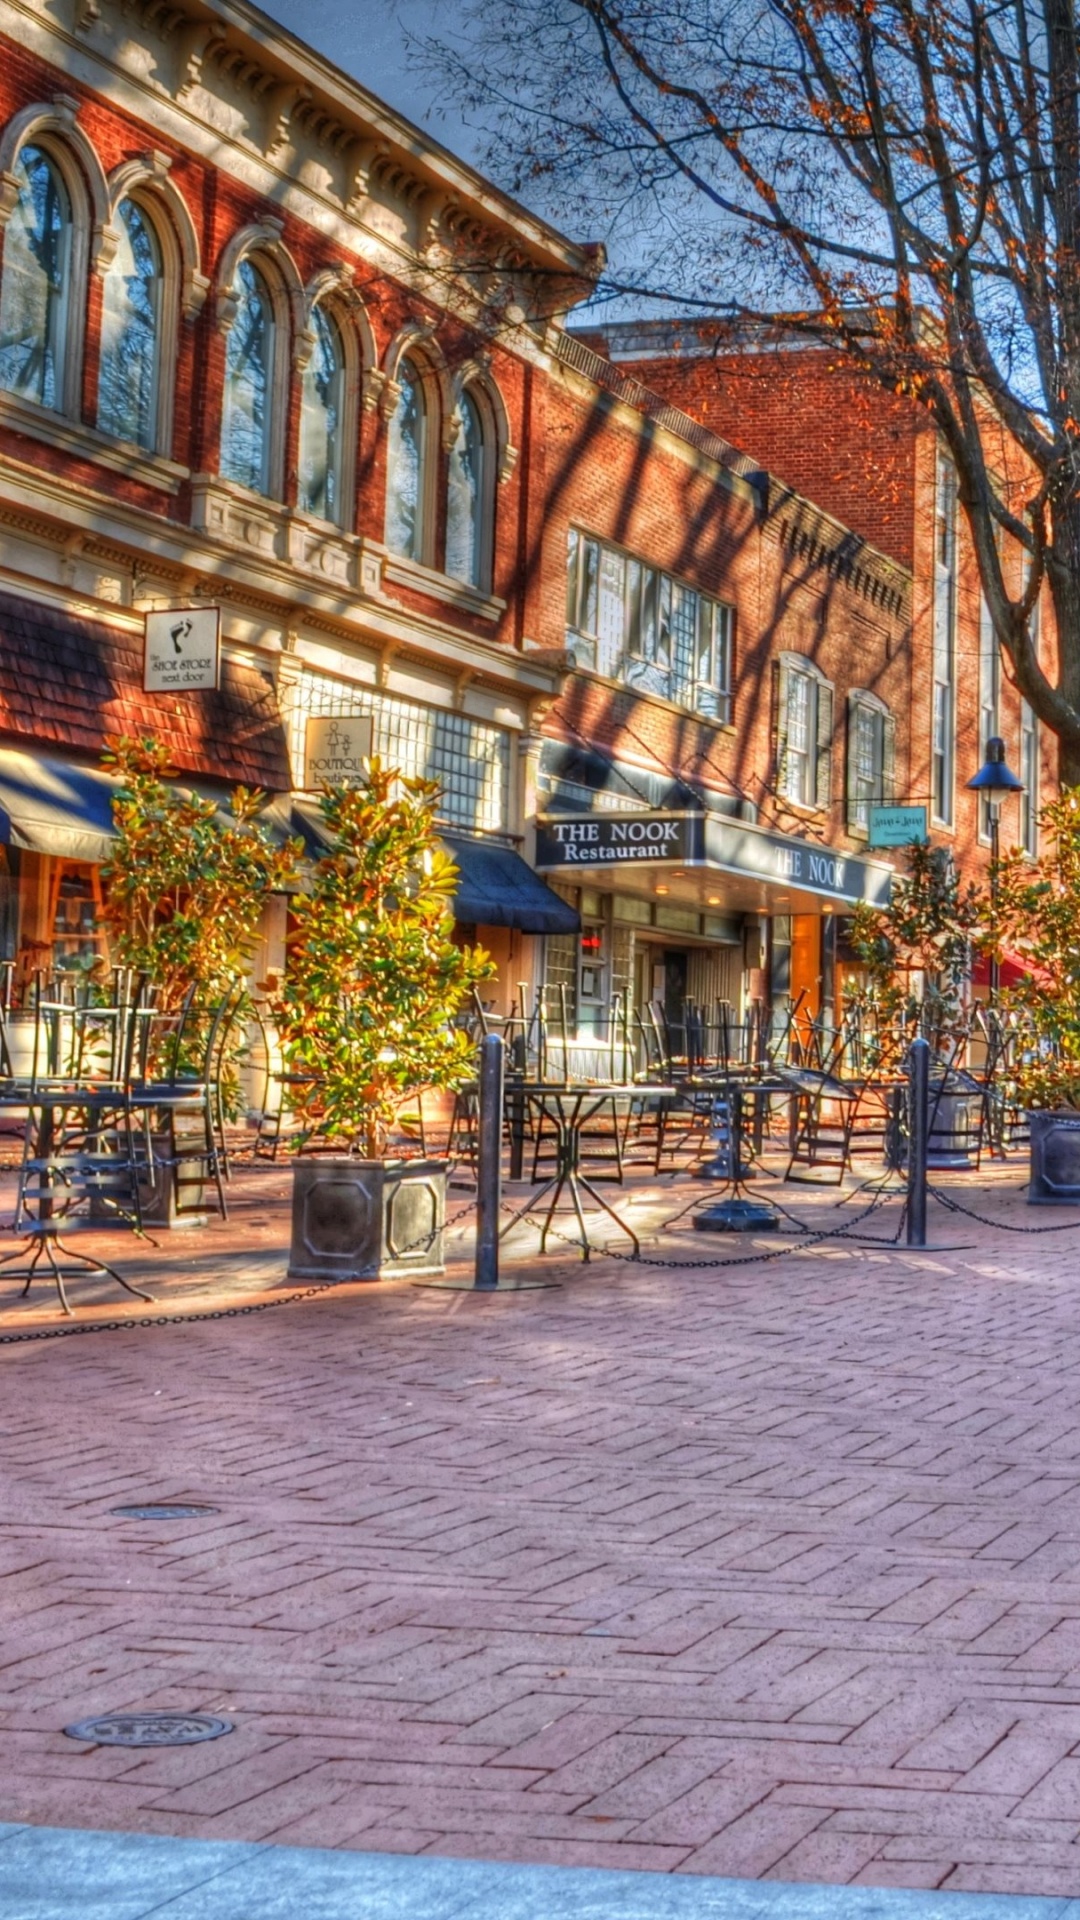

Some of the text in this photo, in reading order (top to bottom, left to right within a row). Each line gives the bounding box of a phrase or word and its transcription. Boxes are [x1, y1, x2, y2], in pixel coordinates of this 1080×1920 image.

[151, 658, 211, 671] SHOE STORE
[161, 671, 205, 683] next door
[309, 758, 363, 772] BOUTIQU
[553, 822, 679, 842] THE NOOK
[564, 842, 668, 861] Restaurant
[775, 846, 845, 888] THE NOOK
